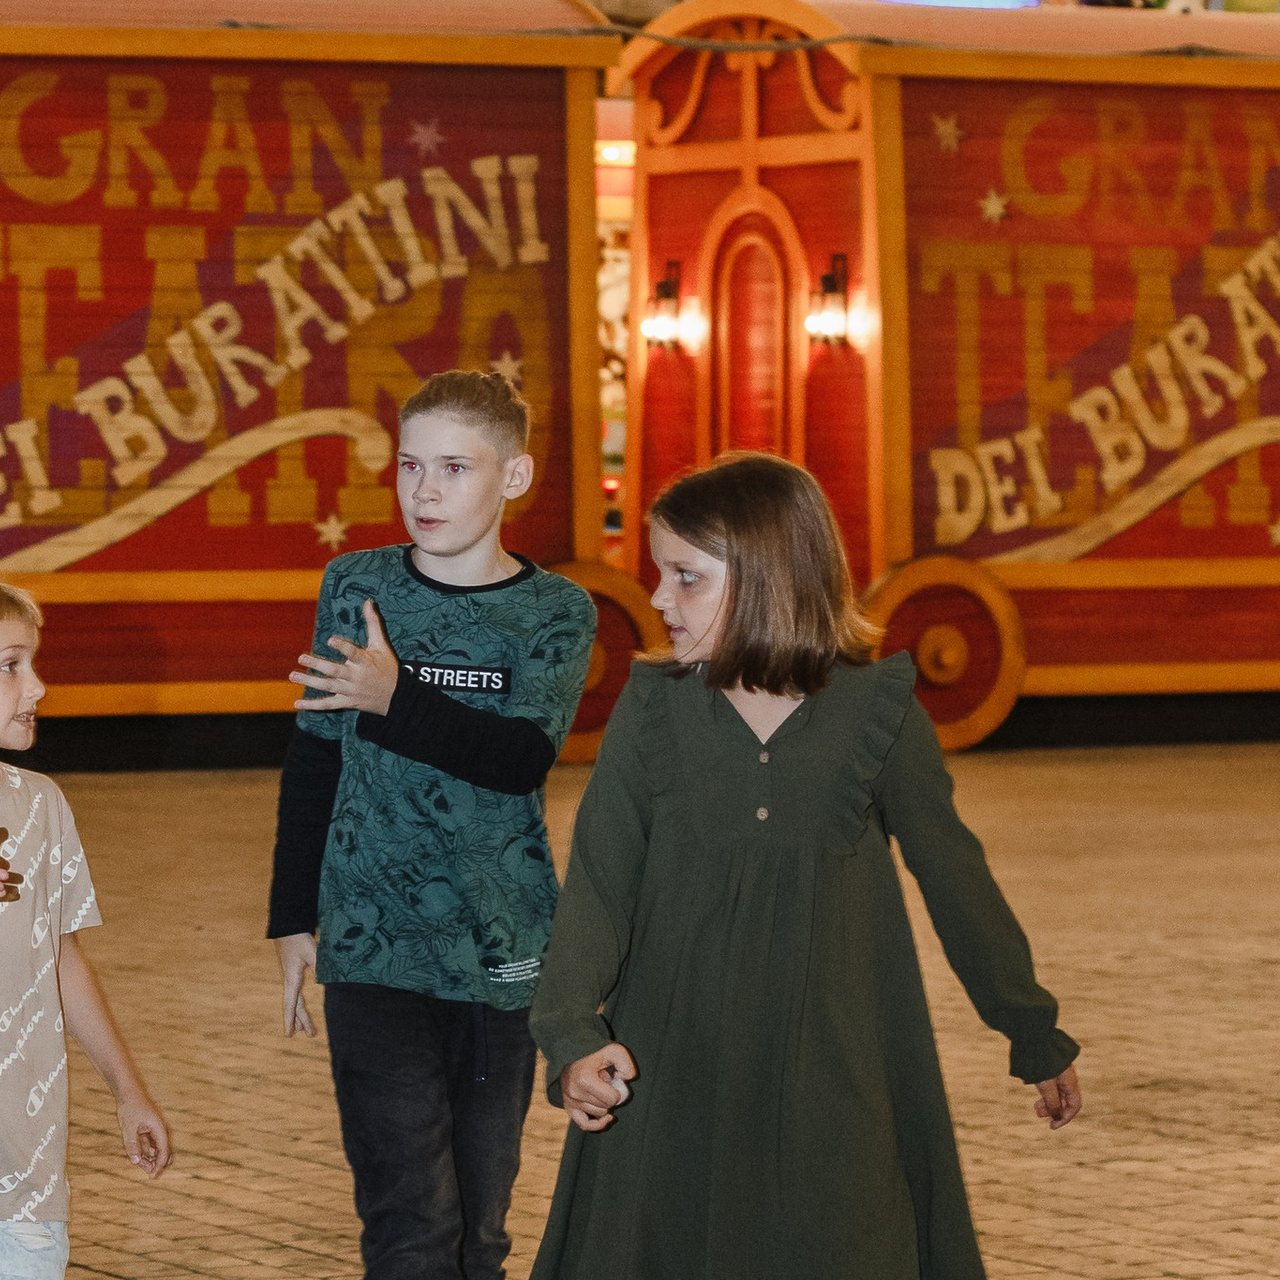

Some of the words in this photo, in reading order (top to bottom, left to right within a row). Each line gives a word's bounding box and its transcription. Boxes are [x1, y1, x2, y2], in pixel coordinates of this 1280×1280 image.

[73, 154, 550, 486] BURATTINI
[419, 667, 503, 689] STREETS
[0, 792, 43, 861] Champion
